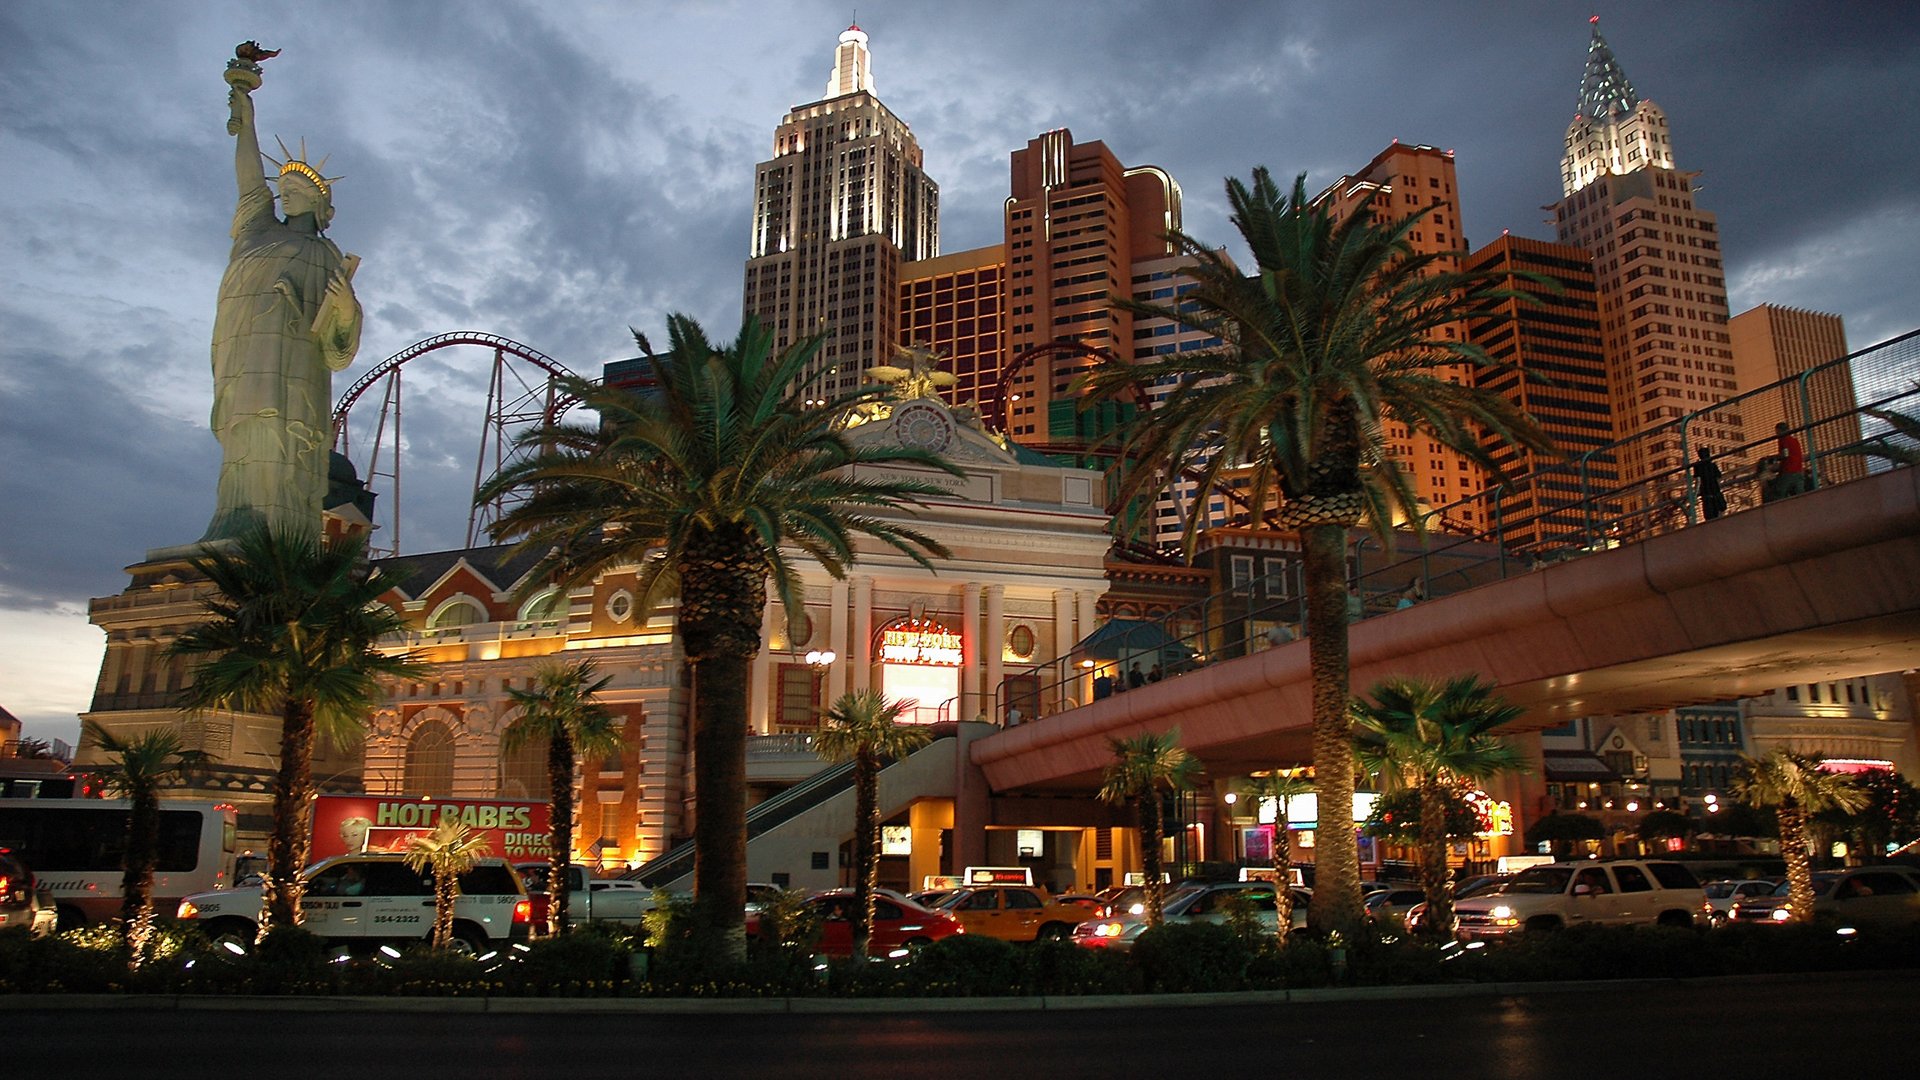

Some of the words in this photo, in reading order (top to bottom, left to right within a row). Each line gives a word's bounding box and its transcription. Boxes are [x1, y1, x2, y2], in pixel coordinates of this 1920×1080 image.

[884, 631, 919, 646] NEW
[920, 633, 962, 648] YORK
[377, 802, 437, 827] HOT
[440, 804, 531, 831] BABES
[504, 832, 551, 846] DIREC
[504, 846, 525, 857] TO
[527, 846, 552, 857] YO
[36, 879, 96, 891] huttle
[302, 901, 323, 910] ERSON
